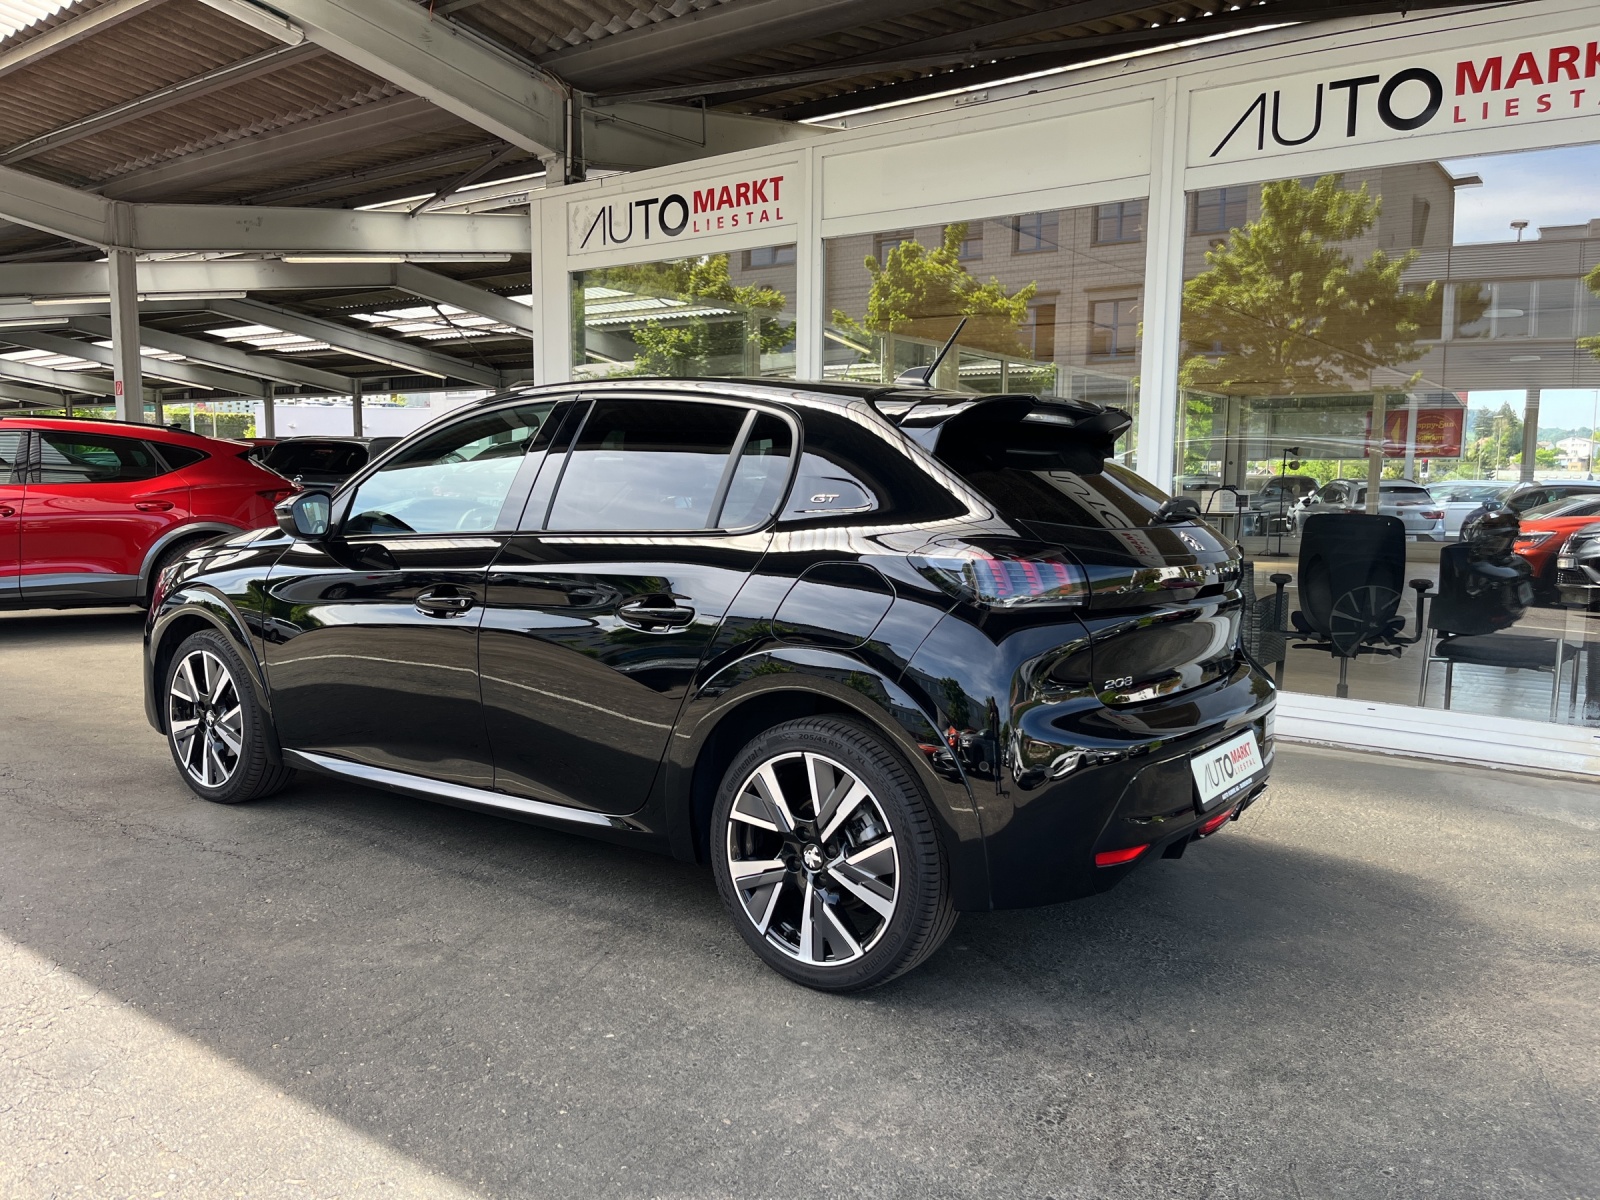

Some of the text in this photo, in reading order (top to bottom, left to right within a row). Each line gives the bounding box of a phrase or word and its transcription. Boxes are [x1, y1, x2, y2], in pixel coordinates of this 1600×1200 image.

[1209, 67, 1443, 157] AUTO
[1453, 89, 1600, 123] LIEST
[580, 175, 784, 249] AUTO MARKT
[693, 207, 784, 233] LIESTAL
[810, 493, 840, 503] GT
[1104, 676, 1133, 690] 208
[798, 733, 827, 744] 205/45
[828, 739, 843, 750] R17
[726, 748, 760, 793] Continental
[1204, 754, 1235, 793] AUTO
[1230, 741, 1252, 765] MARKT
[1233, 758, 1256, 775] LIESTAL
[862, 932, 900, 975] Continental
